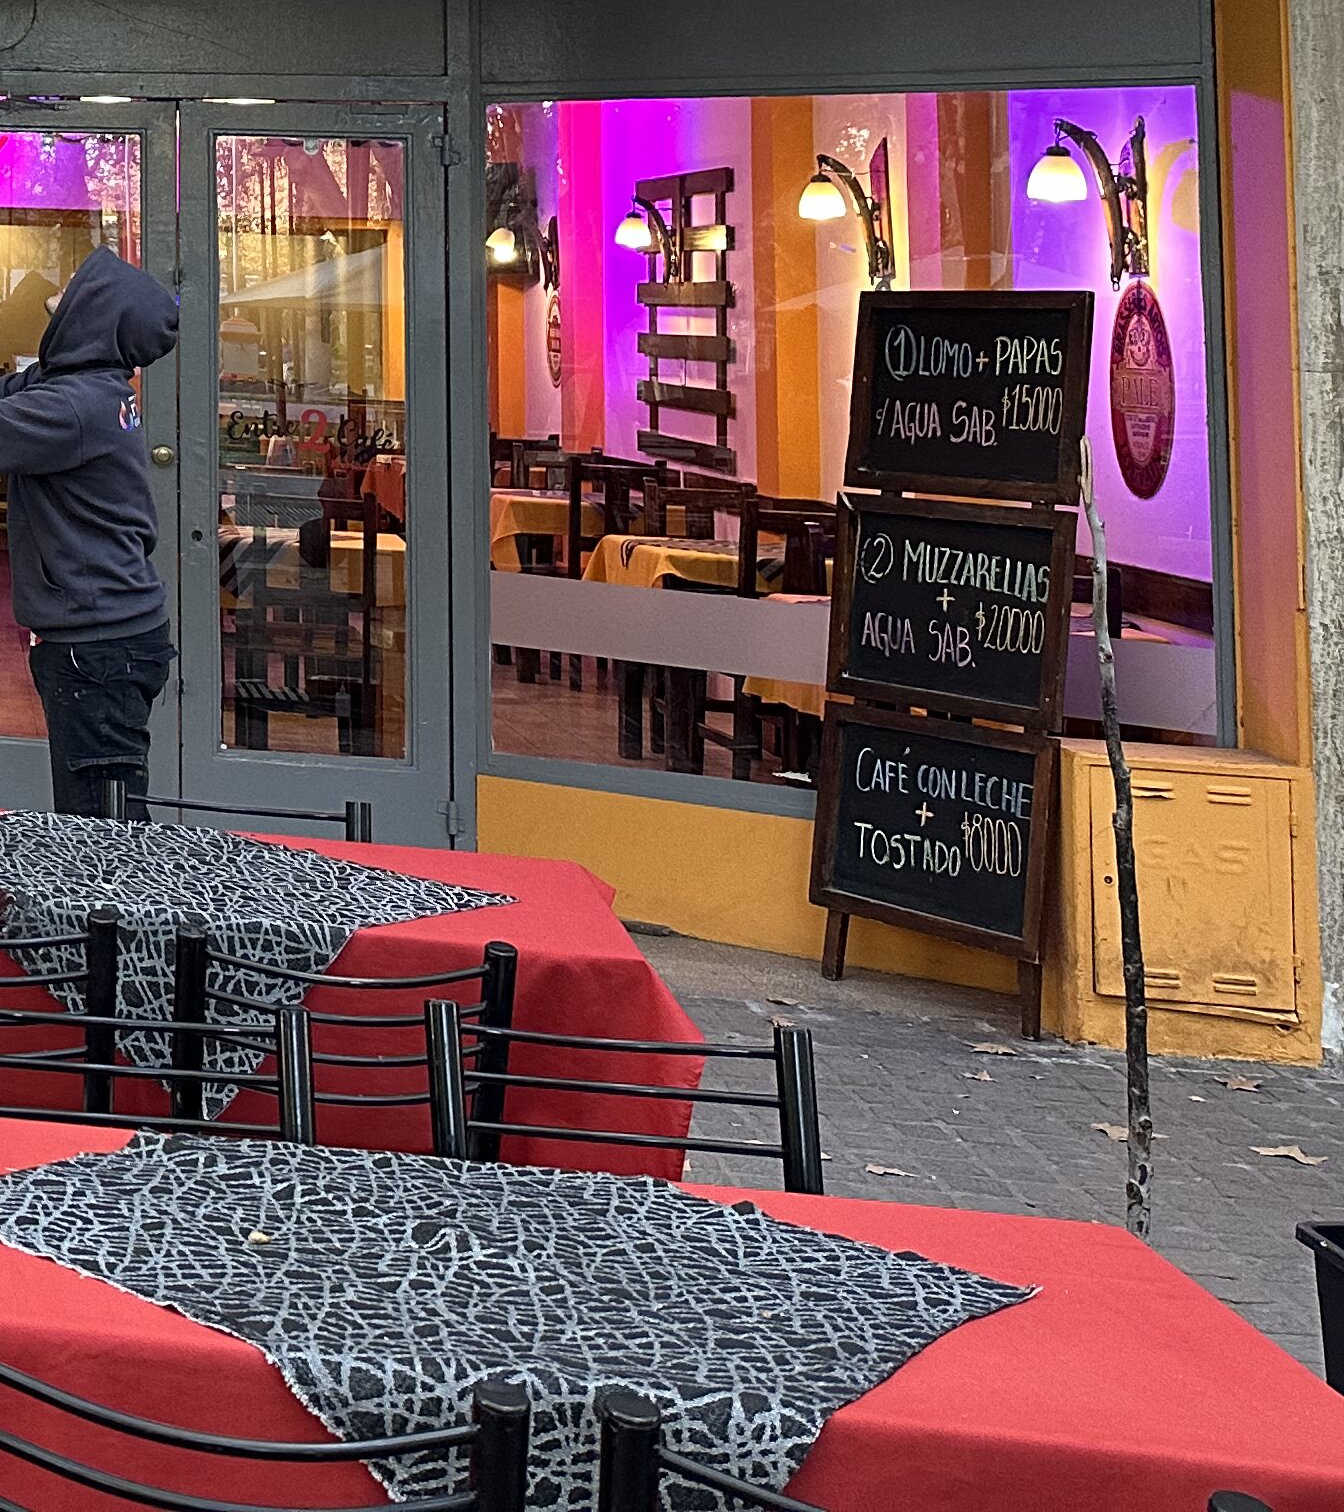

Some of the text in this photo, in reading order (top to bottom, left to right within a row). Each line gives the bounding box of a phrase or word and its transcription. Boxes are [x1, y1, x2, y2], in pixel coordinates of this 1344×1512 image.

[918, 336, 972, 378] LOMO
[995, 336, 1063, 376] PAPAS
[891, 401, 941, 445] AGUA
[1001, 384, 1063, 435] $15000
[903, 539, 1050, 604] MUZZARELLAS
[862, 611, 915, 658] AGUA
[975, 602, 1045, 654] $20000
[856, 747, 1034, 819] CAFÉ CON LECHE
[854, 811, 1022, 878] TOSTADO $8000
